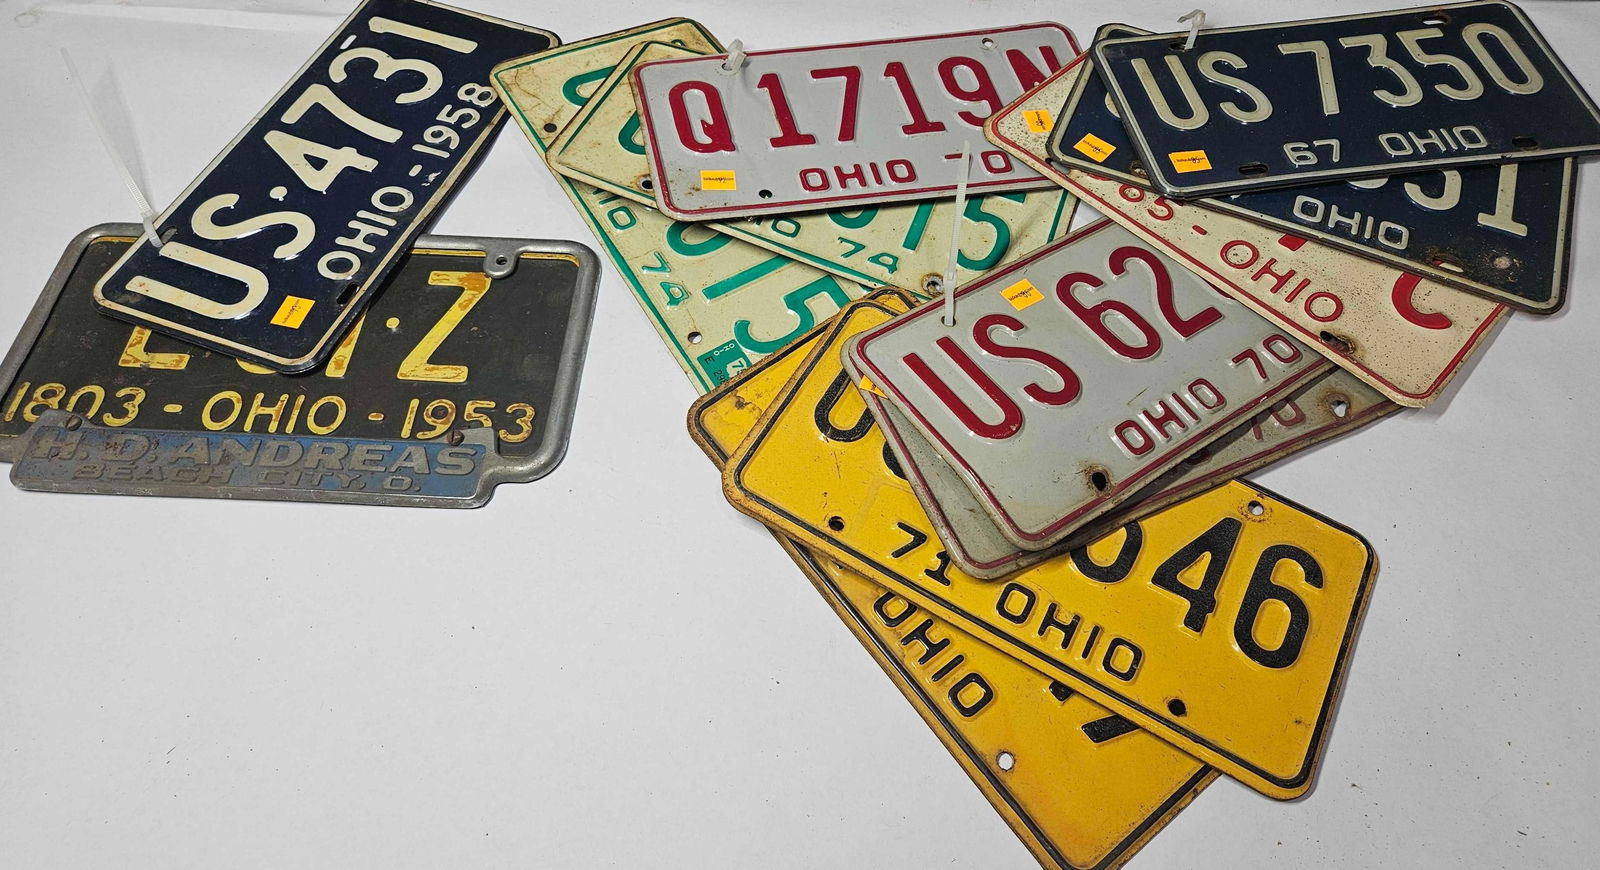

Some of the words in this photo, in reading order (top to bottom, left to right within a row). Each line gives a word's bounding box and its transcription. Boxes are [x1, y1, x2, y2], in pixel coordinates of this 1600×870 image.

[1131, 50, 1273, 130] US
[1277, 22, 1544, 116] 7350
[799, 159, 917, 191] OHIO
[1283, 138, 1341, 166] 67
[1378, 125, 1488, 156] OHIO
[317, 187, 414, 280] OHIO
[425, 82, 498, 158] 1958
[1293, 195, 1409, 250] OHIO
[642, 251, 689, 306] 74
[838, 237, 899, 274] 74
[1220, 240, 1343, 322] OHIO
[902, 314, 1081, 440] US
[1056, 246, 1232, 360] 62
[4, 381, 146, 427] 1803
[201, 390, 347, 435] OHIO
[400, 398, 536, 443] 1953
[1114, 378, 1226, 456] OHIO
[1232, 334, 1302, 380] 70
[72, 463, 234, 486] BEACH
[168, 436, 477, 476] ANDREAS
[873, 592, 995, 718] OHIO
[995, 582, 1144, 681] OHIO
